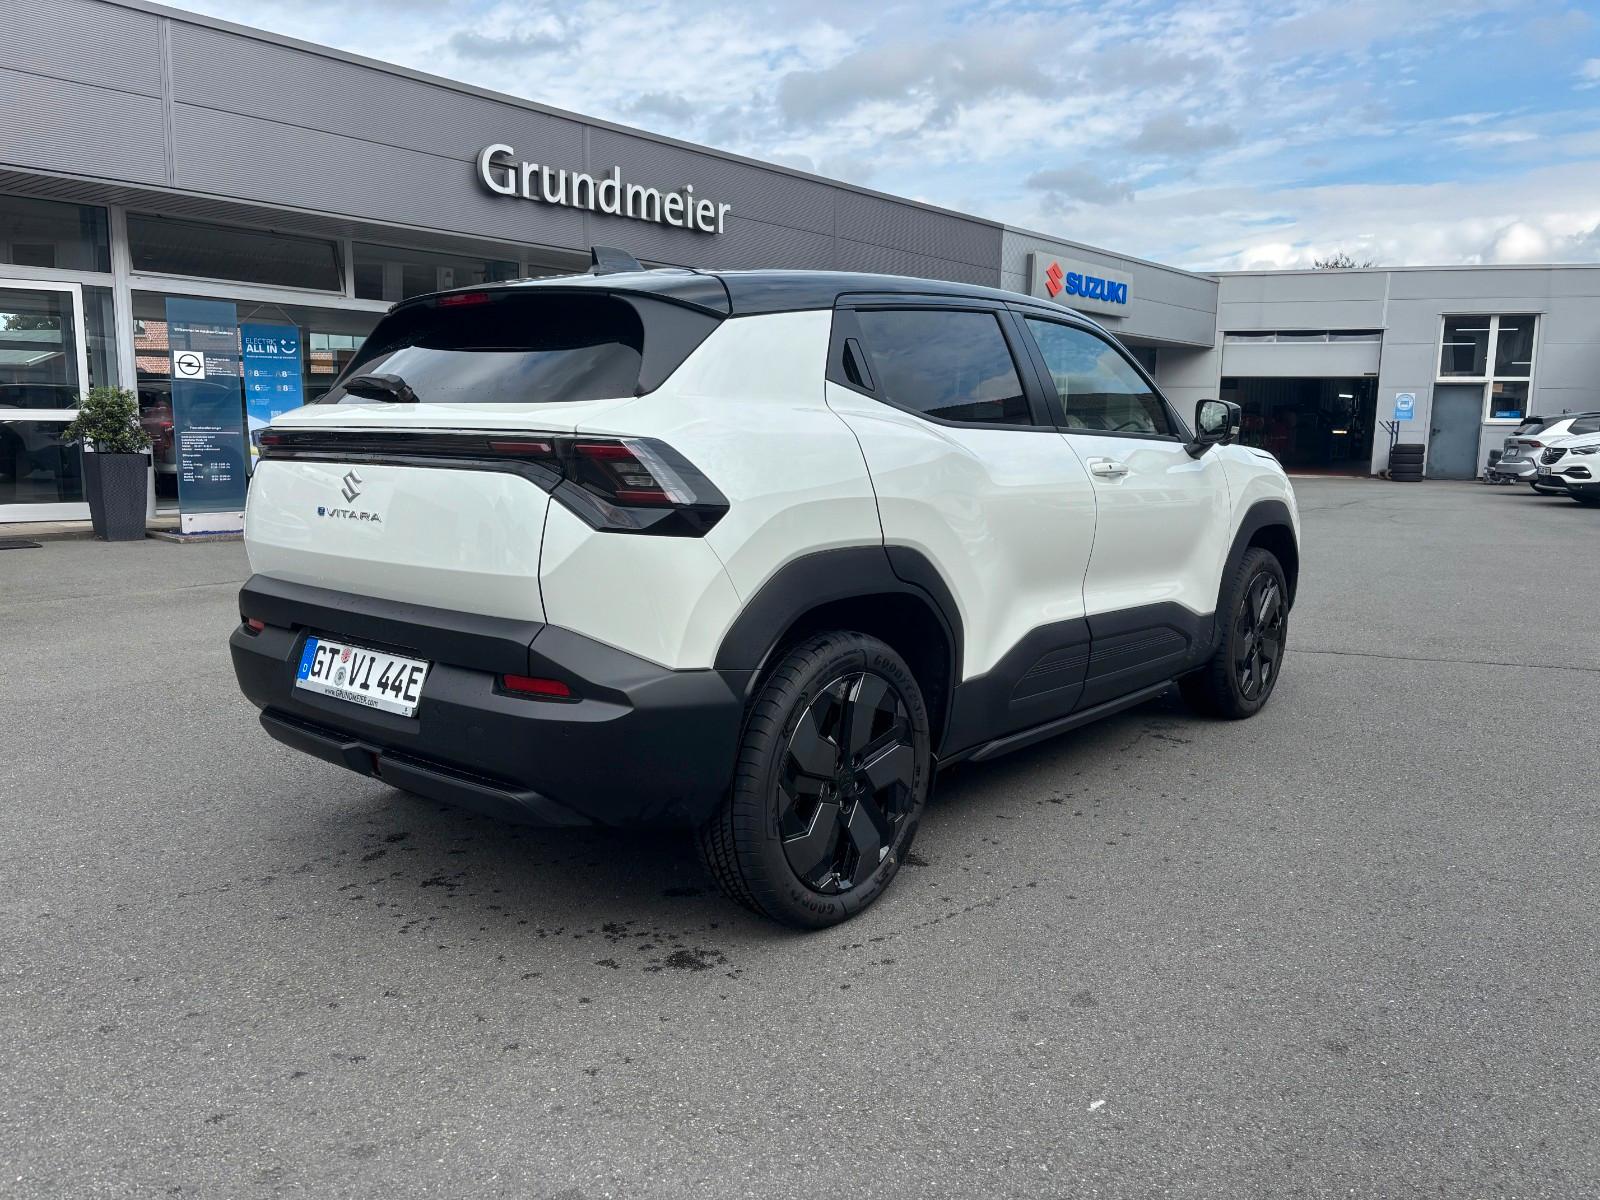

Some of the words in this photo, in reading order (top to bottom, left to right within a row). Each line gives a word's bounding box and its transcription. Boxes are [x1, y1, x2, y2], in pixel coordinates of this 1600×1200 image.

[477, 143, 732, 234] Grundmeier
[1065, 271, 1128, 305] SUZUKI
[245, 337, 277, 346] ELECTRIC
[246, 344, 265, 353] ALL
[267, 345, 278, 354] IN
[310, 644, 341, 681] GT
[348, 652, 376, 691] VI
[376, 661, 424, 703] 44E
